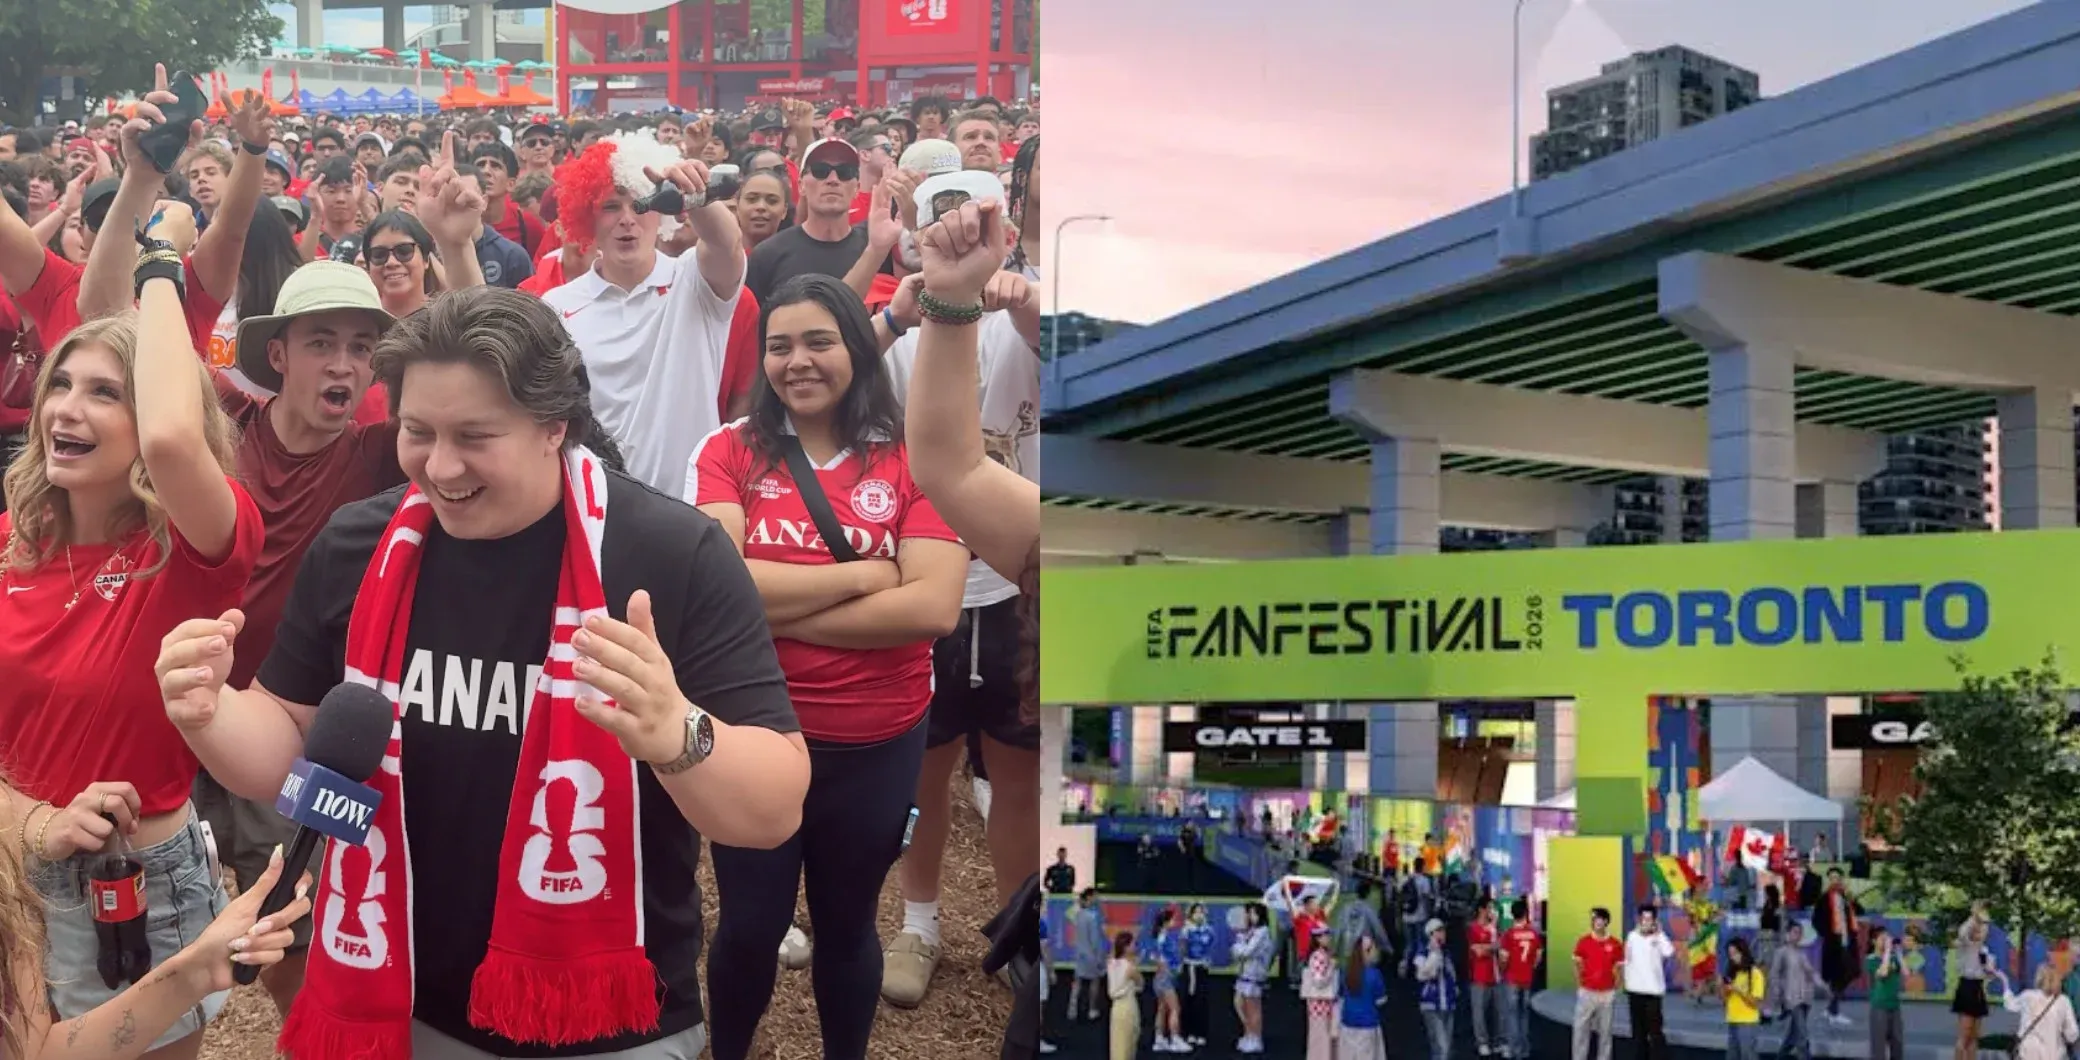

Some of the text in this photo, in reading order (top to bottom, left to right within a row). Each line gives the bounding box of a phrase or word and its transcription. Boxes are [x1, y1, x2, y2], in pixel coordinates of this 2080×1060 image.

[1147, 607, 1163, 659] FIFA
[1526, 594, 1543, 650] 2026
[1562, 581, 1990, 649] TORONTO
[1195, 726, 1333, 747] GATE 1
[311, 787, 373, 831] now.
[540, 875, 583, 893] FIFA
[334, 935, 372, 958] FIFA
